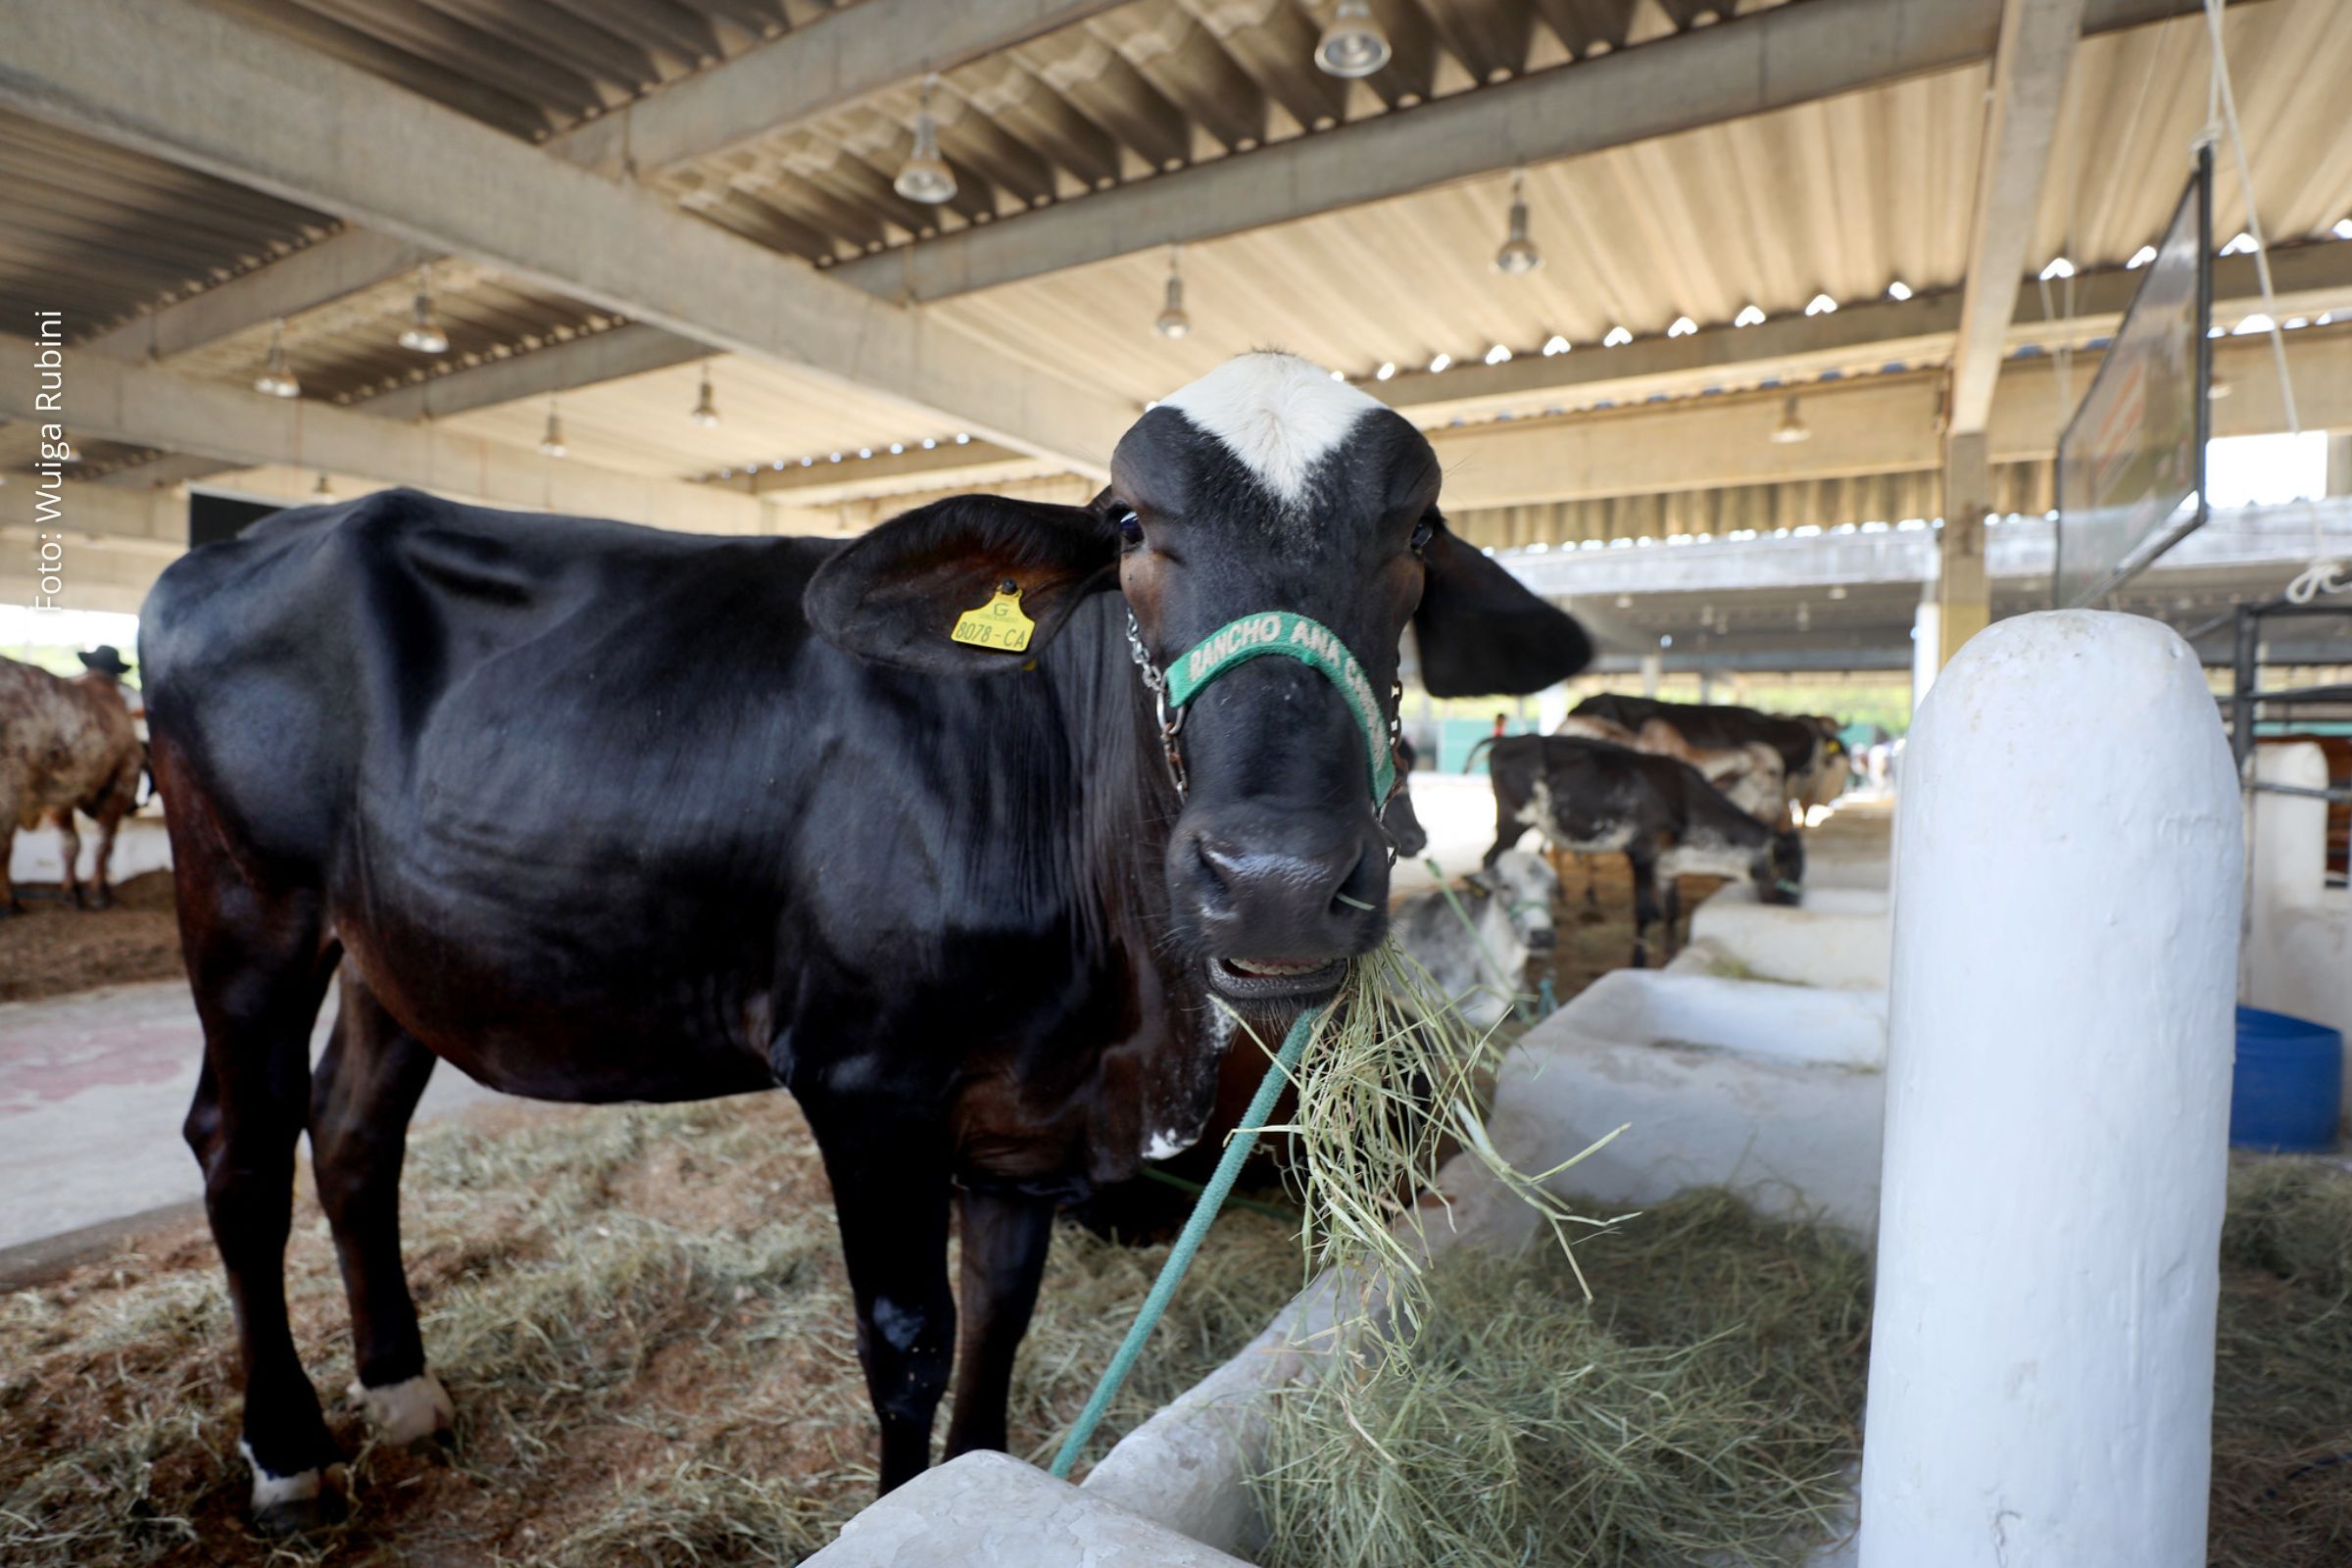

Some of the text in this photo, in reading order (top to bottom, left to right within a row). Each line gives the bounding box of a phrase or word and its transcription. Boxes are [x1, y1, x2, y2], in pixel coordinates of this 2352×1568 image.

[993, 602, 1010, 617] G
[1188, 613, 1342, 682] RANCHO ANA
